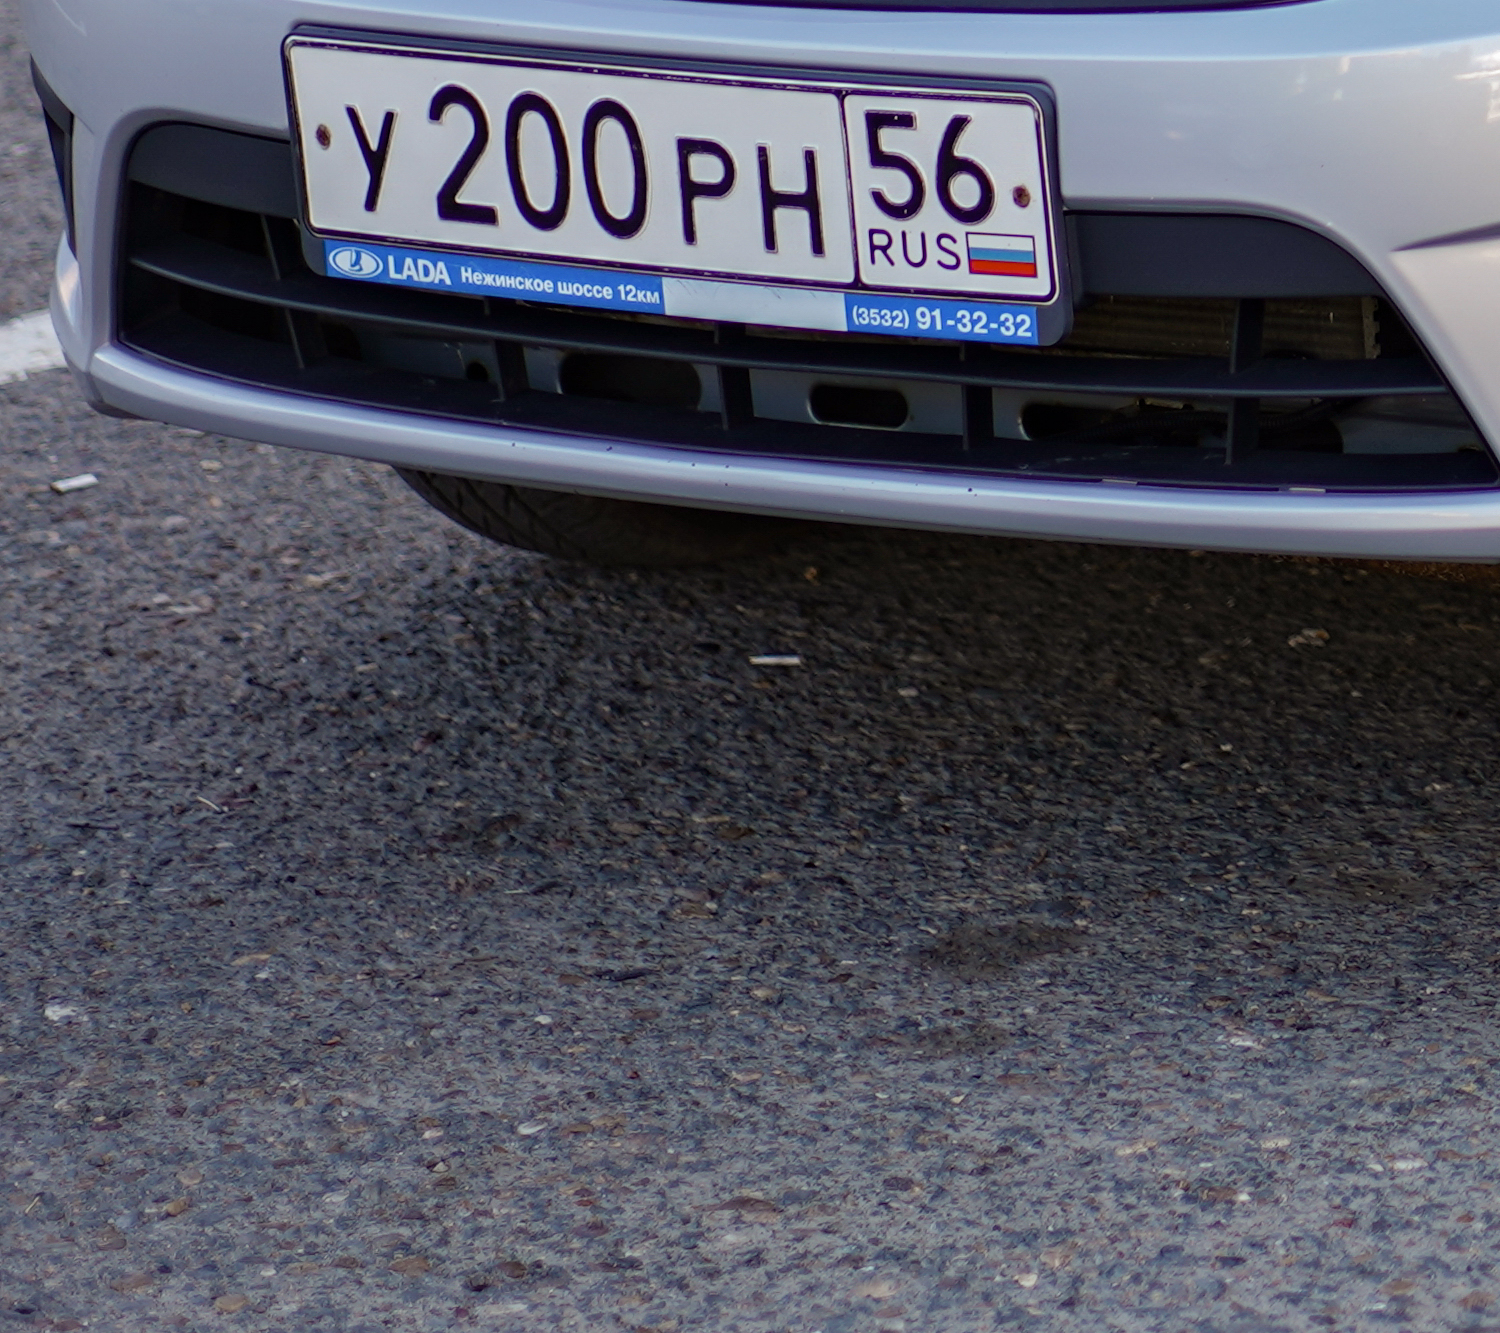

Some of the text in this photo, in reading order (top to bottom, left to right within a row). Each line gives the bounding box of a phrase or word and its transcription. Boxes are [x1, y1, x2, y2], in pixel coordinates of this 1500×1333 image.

[864, 111, 997, 226] 56
[868, 227, 962, 272] RUS
[387, 255, 661, 306] LADA Нежинское шоссе 12км
[851, 304, 1033, 339] (3532) 91-32-32
